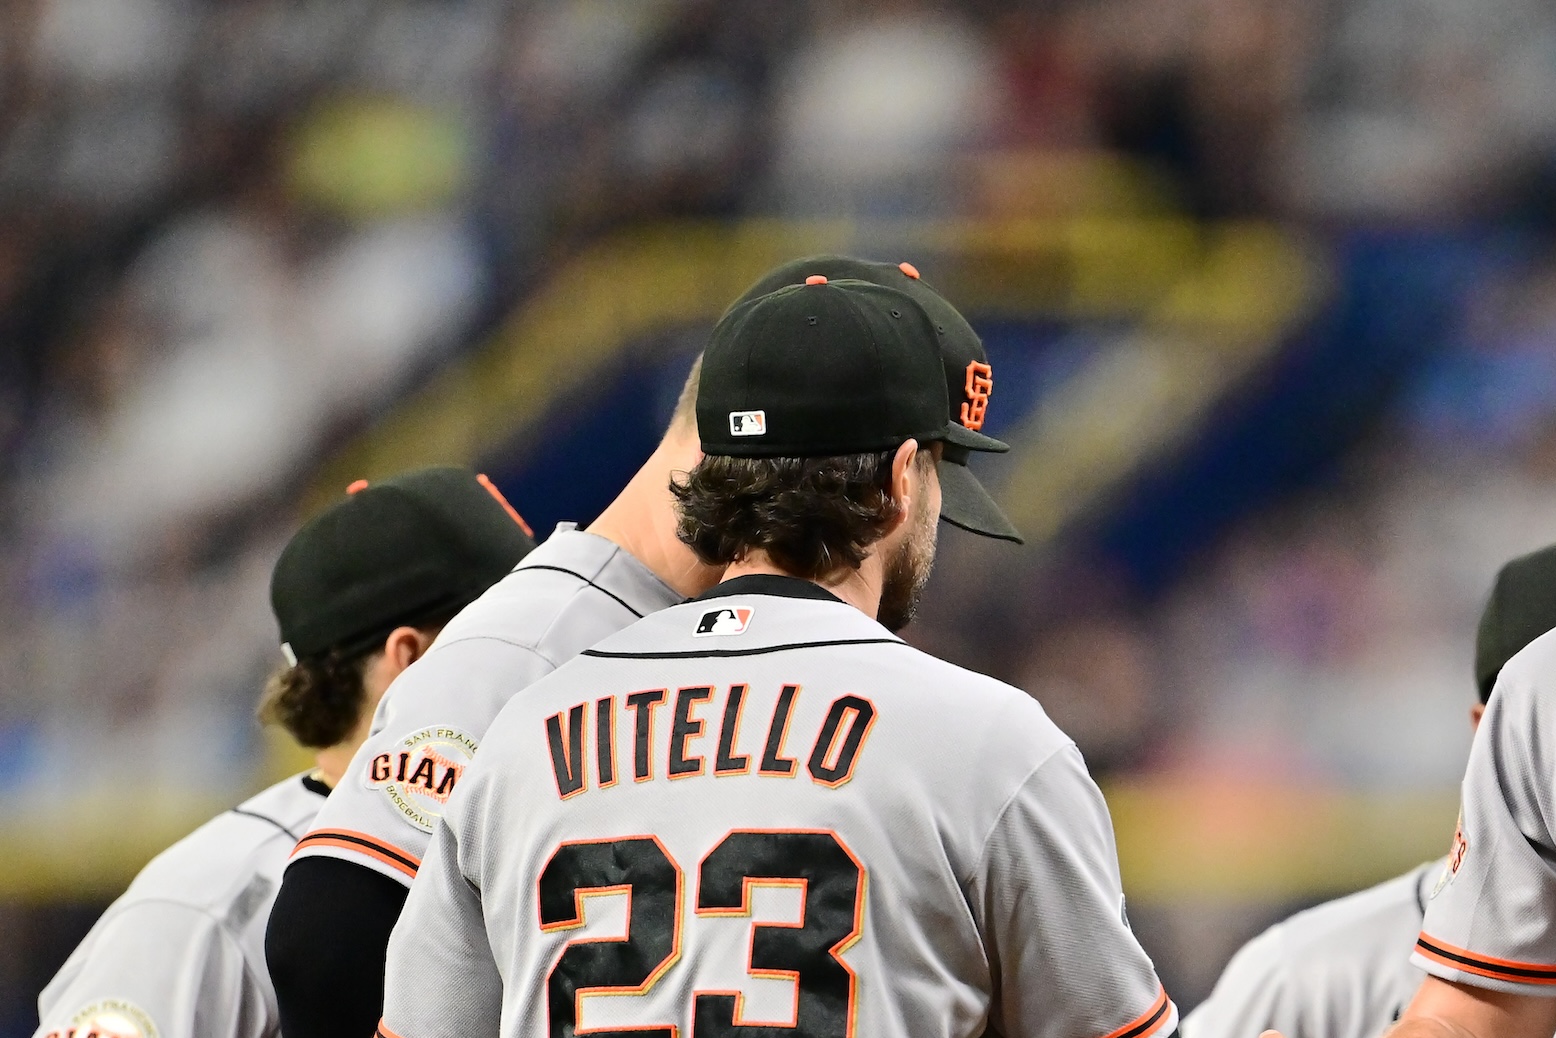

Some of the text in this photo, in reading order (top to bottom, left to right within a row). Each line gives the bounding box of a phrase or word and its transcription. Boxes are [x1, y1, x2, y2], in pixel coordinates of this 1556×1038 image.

[404, 730, 432, 747] SAN
[544, 683, 879, 800] VITELLO
[386, 785, 434, 829] BASEBALL
